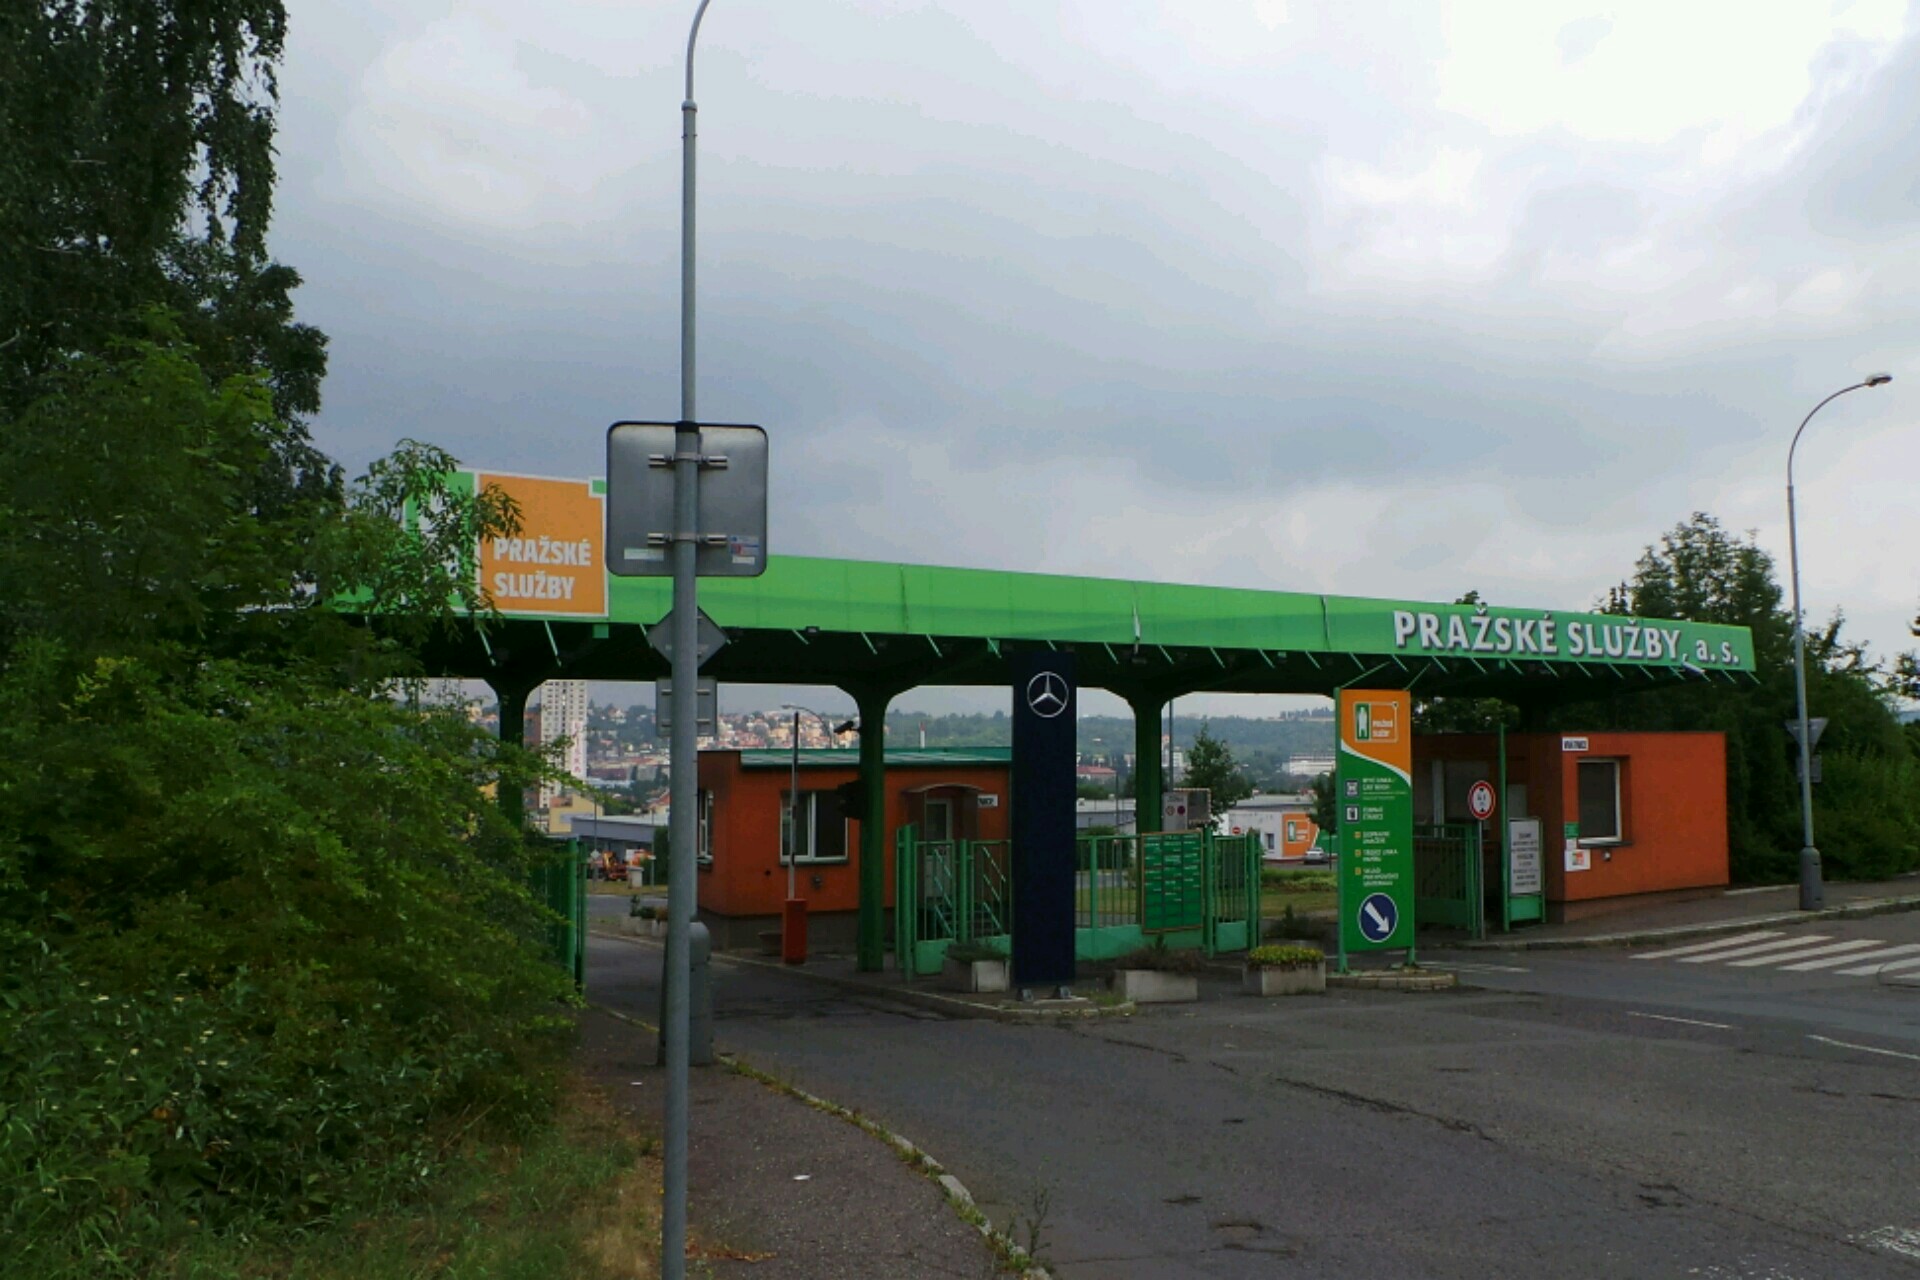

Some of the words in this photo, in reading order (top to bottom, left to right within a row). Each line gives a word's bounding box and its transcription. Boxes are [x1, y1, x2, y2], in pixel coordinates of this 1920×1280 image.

[493, 535, 592, 566] PRAŽSKÉ
[493, 570, 576, 600] SLUŽBY
[1393, 608, 1558, 654] PRAŽSKÉ
